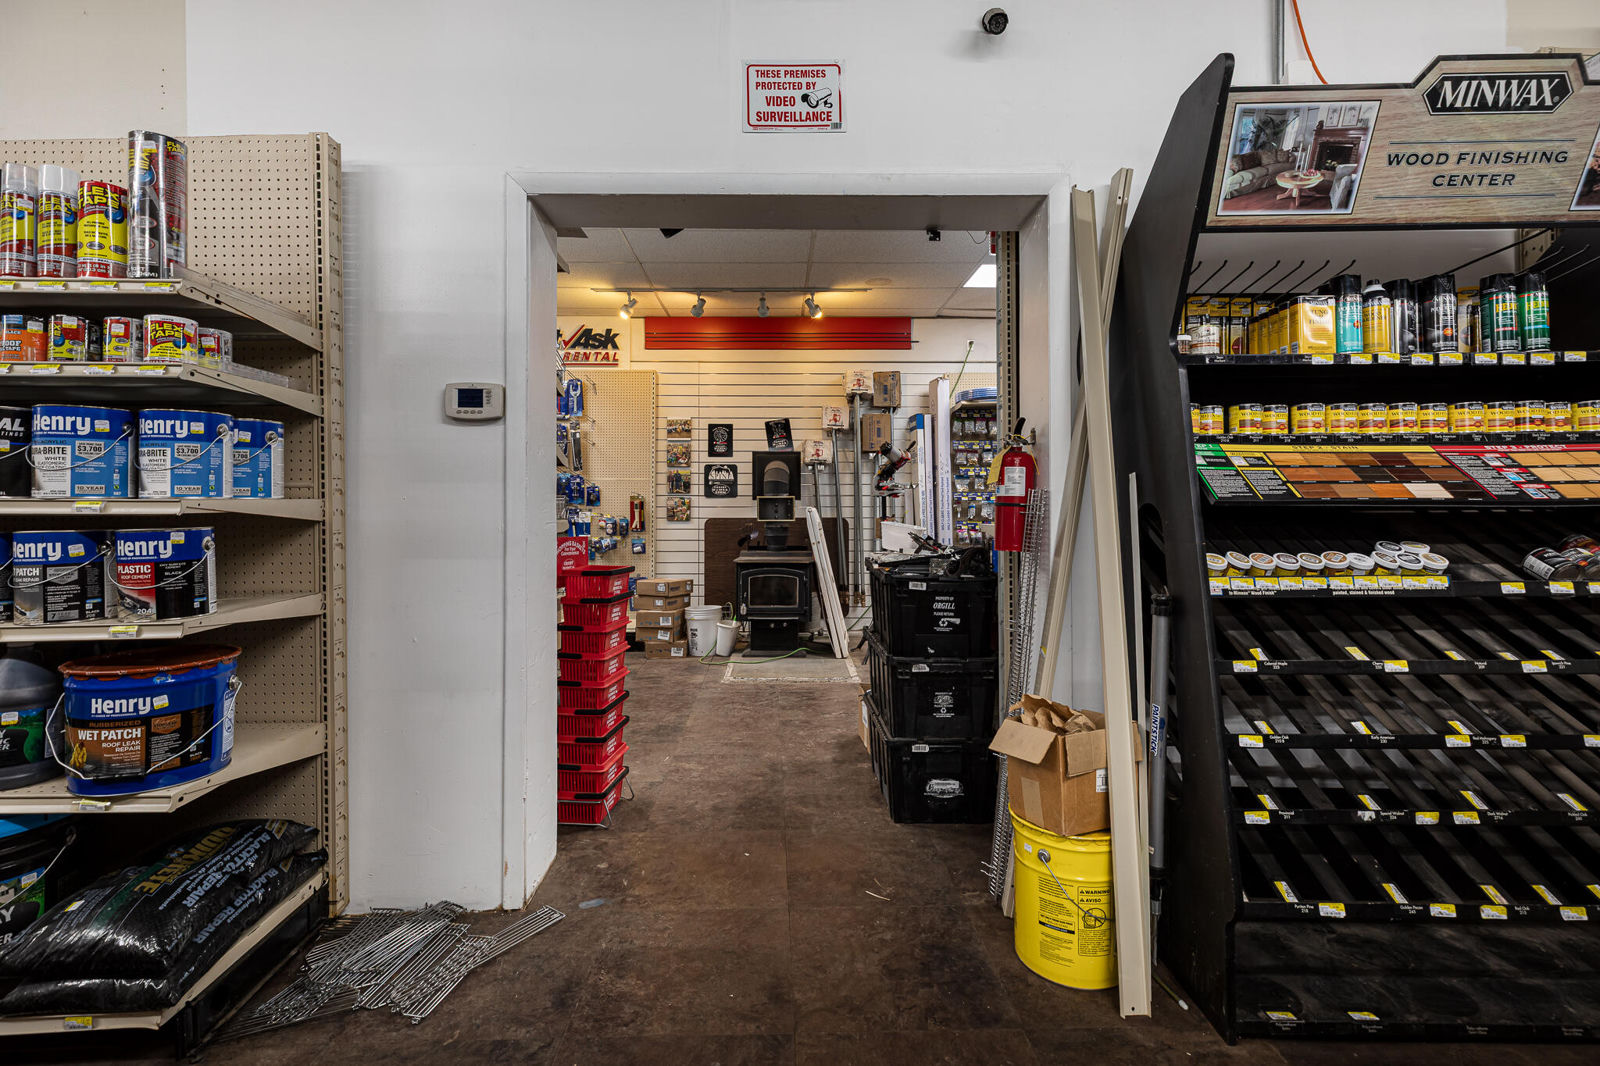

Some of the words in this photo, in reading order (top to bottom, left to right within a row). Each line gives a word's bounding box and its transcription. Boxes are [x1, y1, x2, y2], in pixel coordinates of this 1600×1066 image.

[755, 70, 781, 78] THESE
[784, 70, 826, 78] PREMISES
[756, 82, 802, 90] PROTECTED
[806, 82, 816, 90] BY
[1436, 78, 1560, 108] MINWAX
[765, 96, 796, 107] VIDEO
[756, 110, 832, 122] SURVEILLANCE
[1386, 152, 1450, 166] WOOD
[1456, 151, 1568, 165] FINISHING
[1432, 174, 1516, 187] CENTER
[78, 186, 119, 200] FLEX
[78, 197, 119, 209] TAPE
[150, 323, 182, 332] FLEX
[151, 330, 182, 340] TAPE
[569, 328, 620, 350] Ask
[562, 352, 619, 361] RENTAL
[33, 414, 91, 435] Henry
[140, 418, 188, 438] Henry
[118, 540, 172, 558] Henry
[16, 568, 40, 576] PATCH
[118, 565, 151, 574] PLASTIC
[933, 602, 955, 610] ORGILL
[91, 697, 151, 714] Henry
[78, 730, 99, 740] WET
[101, 728, 141, 740] PATCH
[1151, 704, 1160, 756] PAINTSTICK
[192, 906, 235, 944] REPAIR
